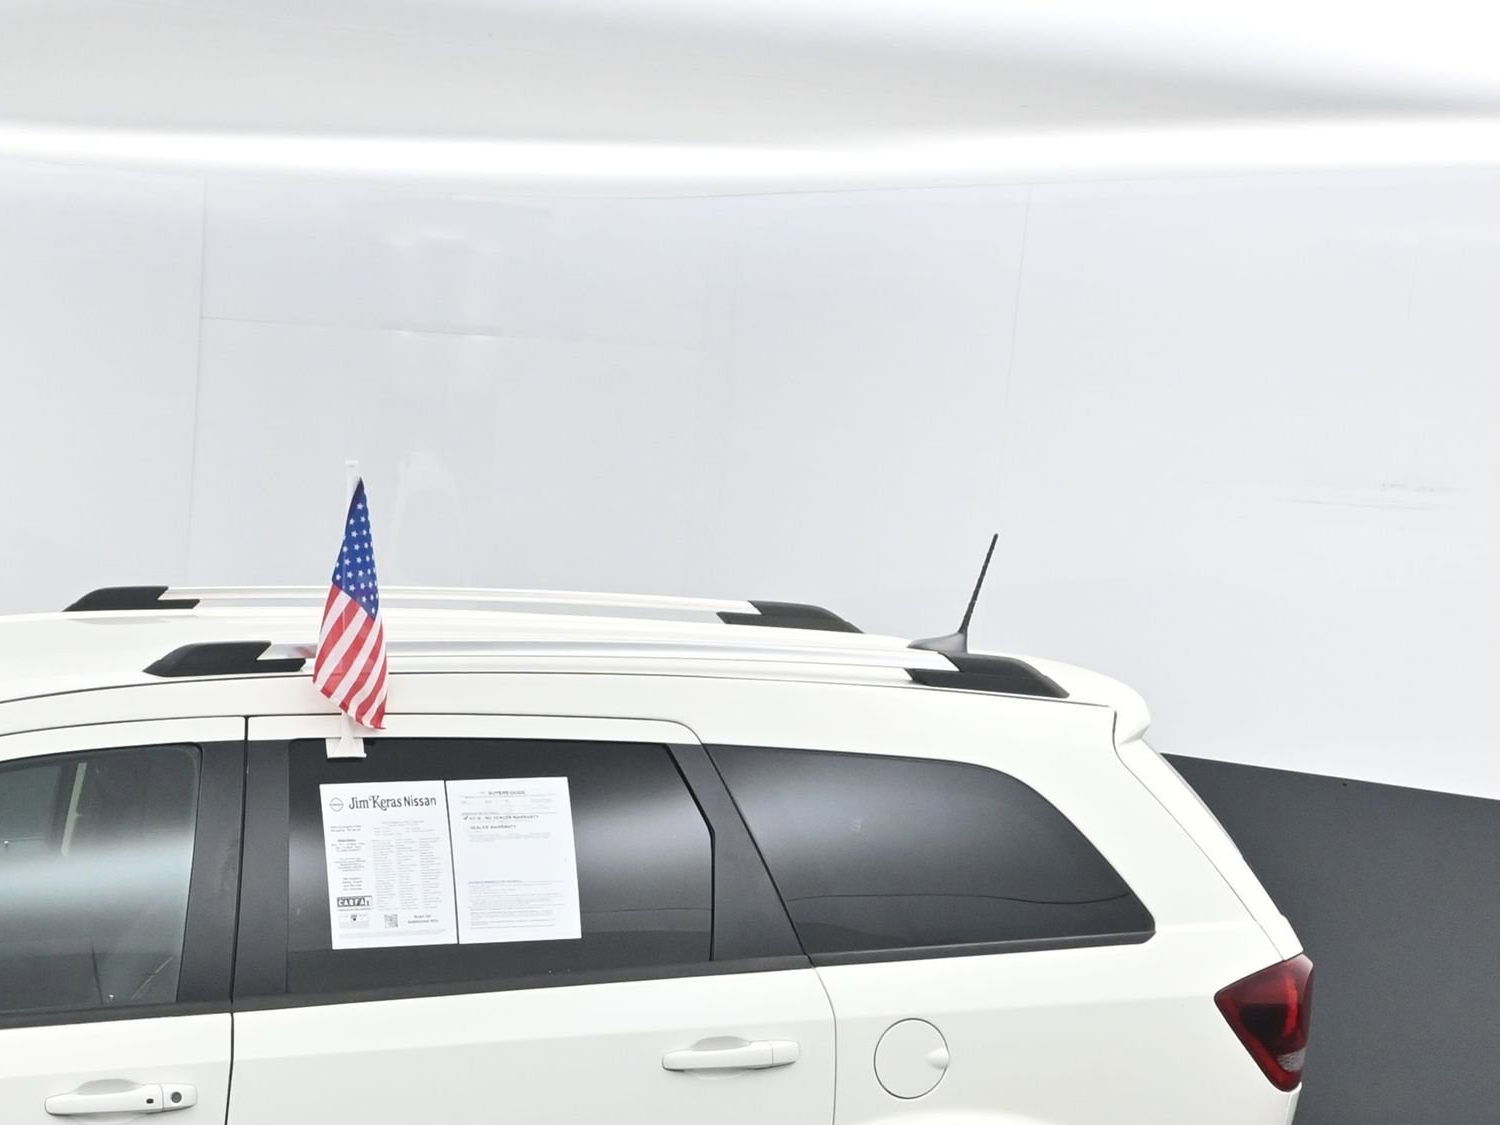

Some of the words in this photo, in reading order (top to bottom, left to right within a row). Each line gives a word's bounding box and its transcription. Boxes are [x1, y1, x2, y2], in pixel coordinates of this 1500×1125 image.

[349, 797, 369, 810] Jim
[369, 795, 402, 811] Keras
[404, 795, 437, 807] Nissan
